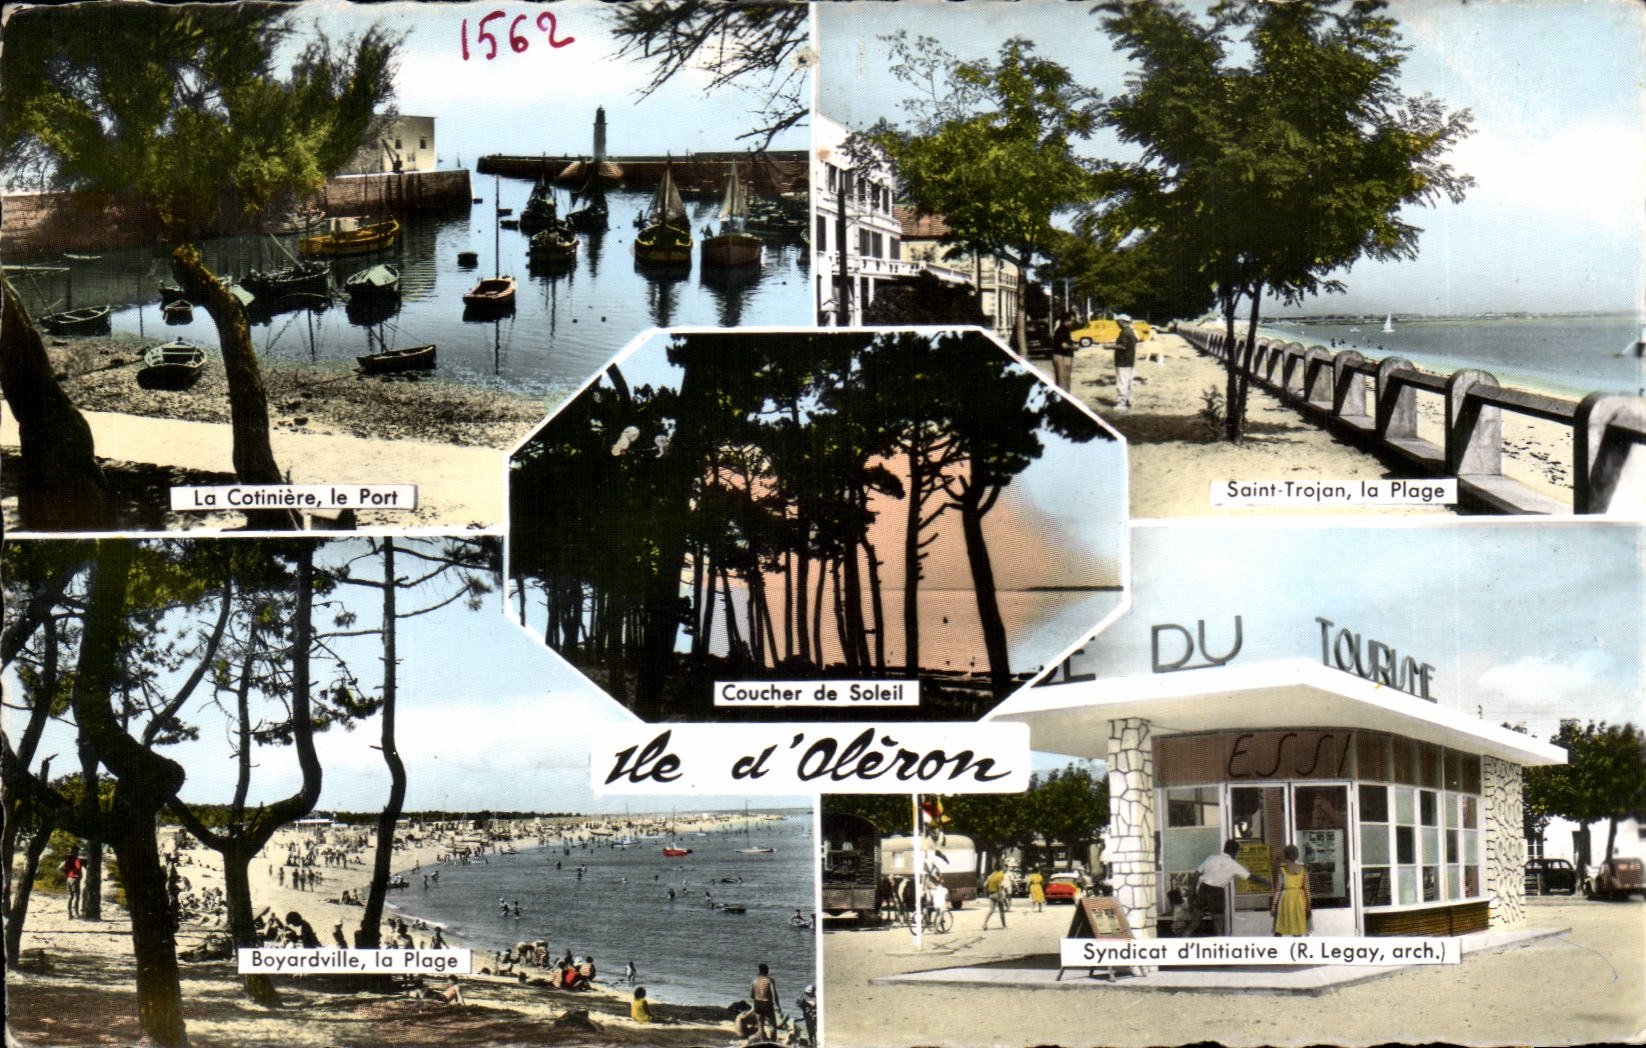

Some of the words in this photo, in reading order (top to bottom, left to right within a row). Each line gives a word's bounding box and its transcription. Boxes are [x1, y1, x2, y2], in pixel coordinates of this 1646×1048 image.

[461, 10, 575, 60] 1562
[1151, 615, 1243, 673] DU
[1314, 616, 1438, 704] TOURISME
